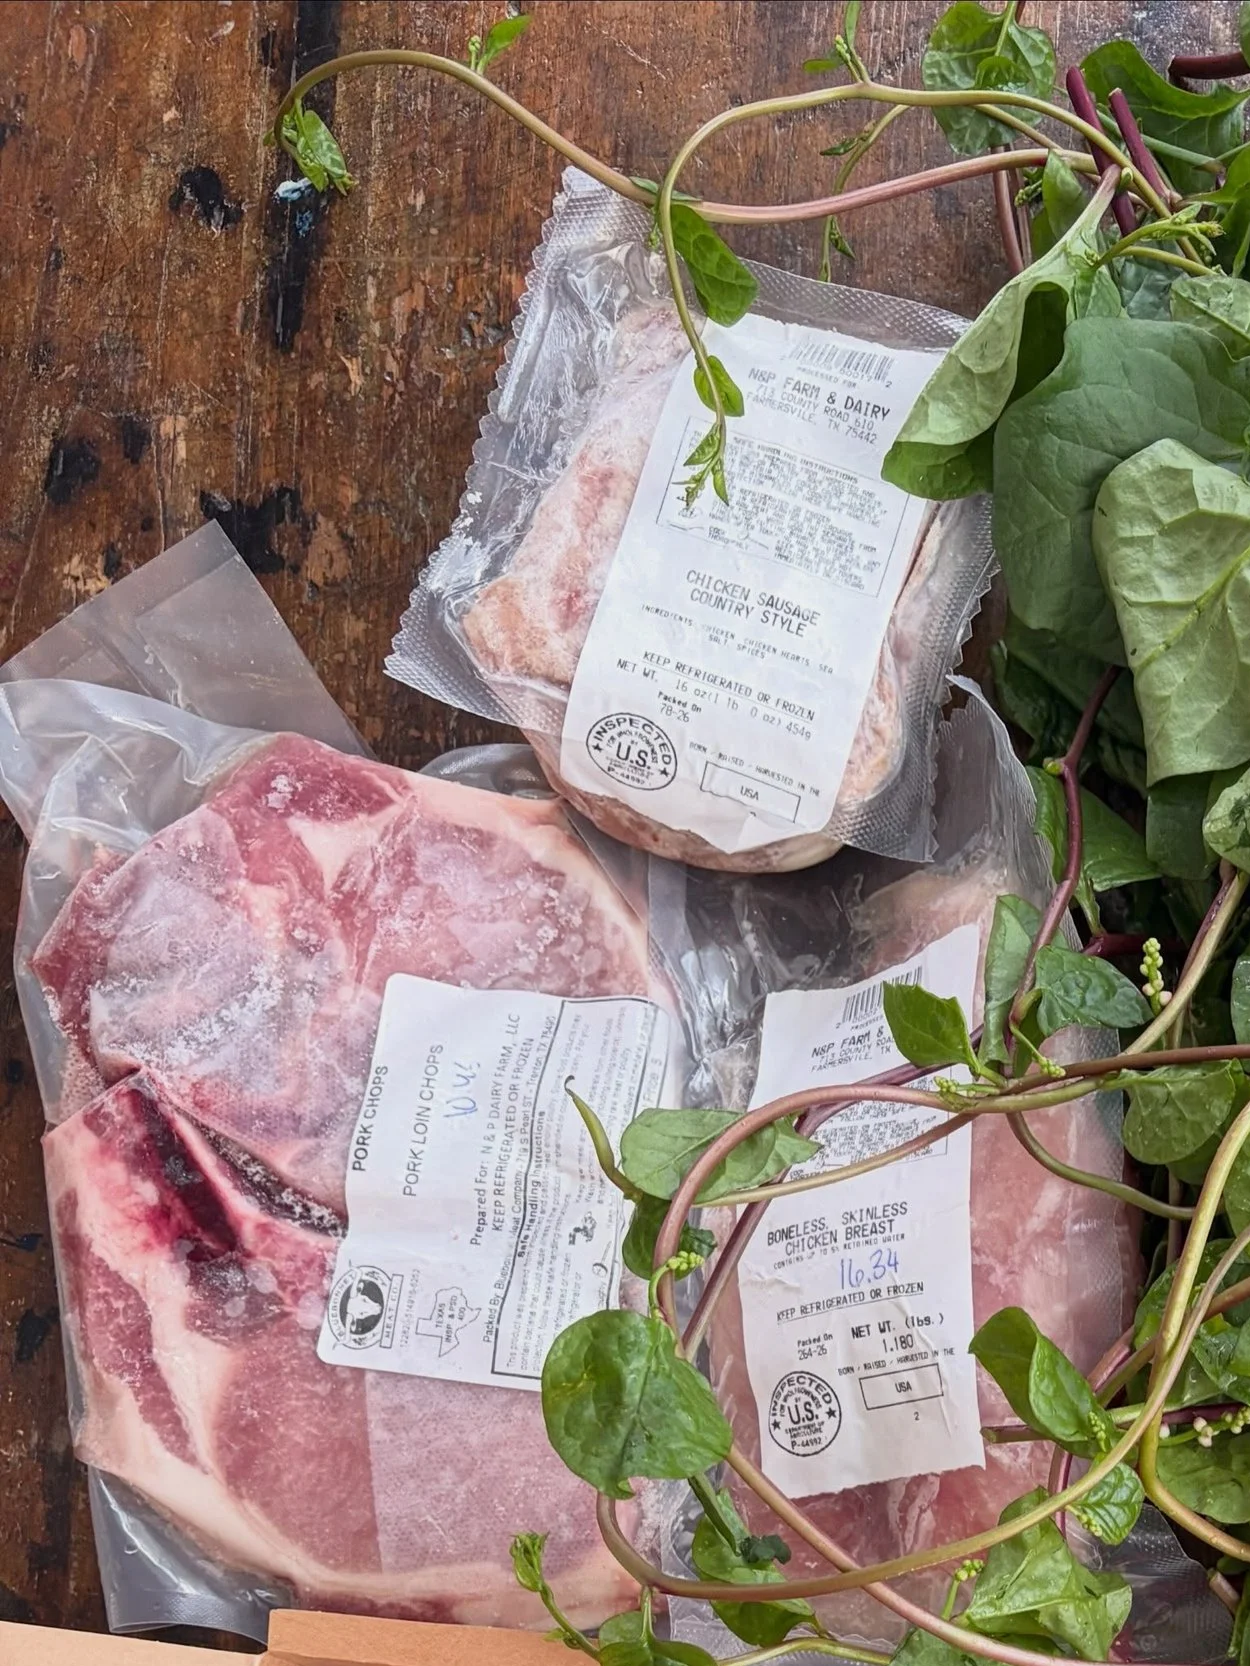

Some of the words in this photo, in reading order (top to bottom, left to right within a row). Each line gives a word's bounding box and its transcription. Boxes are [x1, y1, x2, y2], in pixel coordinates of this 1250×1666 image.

[747, 366, 776, 386] N&P
[783, 377, 821, 400] FARM
[826, 390, 837, 405] &
[843, 395, 890, 422] DAIRY
[779, 391, 819, 412] COUNTY
[822, 405, 850, 423] ROAD
[845, 425, 877, 444] 75442
[685, 568, 750, 603] CHICKEN
[756, 592, 820, 626] SAUSAGE
[689, 587, 753, 620] COUNTRY
[759, 610, 806, 637] STYLE
[616, 658, 636, 674] NET
[674, 679, 688, 693] 16
[725, 698, 739, 712] lb
[642, 650, 670, 669] KEEP
[674, 662, 752, 698] REFRIGERATED
[756, 691, 770, 705] OR
[775, 698, 815, 721] FROZEN
[594, 718, 672, 766] INSPECTED
[614, 741, 654, 769] U.S.
[739, 786, 760, 801] USA
[505, 1012, 520, 1035] LLC
[537, 1040, 547, 1052] TX
[809, 1042, 835, 1058] N&P
[839, 1030, 871, 1048] FARM
[875, 1025, 884, 1038] &
[838, 1041, 872, 1057] COUNTY
[418, 1042, 443, 1101] CHOPS
[493, 1040, 516, 1078] FARM,
[511, 1036, 534, 1080] FROZEN
[487, 1079, 505, 1118] DAIRY
[507, 1082, 521, 1101] OR
[351, 1122, 373, 1172] PORK
[362, 1063, 388, 1120] CHOPS
[411, 1104, 431, 1144] LOIN
[486, 1121, 497, 1129] P
[519, 1108, 531, 1134] Pearl
[480, 1141, 493, 1154] N
[482, 1131, 495, 1142] &
[493, 1103, 518, 1196] REFRIGERATED
[529, 1109, 546, 1177] Instructions
[402, 1147, 423, 1198] PORK
[473, 1159, 490, 1184] For:
[510, 1169, 527, 1214] Company
[524, 1179, 542, 1232] Handling
[468, 1186, 487, 1246] Prepared
[490, 1198, 506, 1232] KEEP
[840, 1201, 909, 1225] SKINLESS
[517, 1233, 530, 1258] Safe
[783, 1229, 838, 1256] CHICKEN
[843, 1218, 897, 1241] BREAST
[842, 1238, 878, 1250] RETAINED
[881, 1233, 905, 1244] WATER
[835, 1245, 902, 1290] 16.34
[489, 1292, 501, 1305] By
[776, 1307, 796, 1321] KEEP
[799, 1291, 865, 1315] REFRIGERATED
[869, 1287, 882, 1299] OR
[886, 1281, 924, 1296] FROZEN
[383, 1307, 394, 1338] MEAT
[435, 1302, 445, 1329] TEXAS
[482, 1307, 497, 1342] Packed
[851, 1324, 871, 1339] NET
[878, 1320, 895, 1333] WT.
[444, 1323, 452, 1343] INSP
[796, 1335, 821, 1347] Packed
[882, 1333, 914, 1353] 1.180
[797, 1344, 827, 1360] 264-26
[837, 1365, 854, 1375] BORN
[863, 1359, 886, 1371] RAISED
[896, 1352, 928, 1363] HARVESTED
[943, 1347, 954, 1356] THE
[769, 1373, 833, 1416] INSPECTED
[895, 1380, 912, 1392] USA
[787, 1400, 819, 1424] U.S.
[913, 1410, 920, 1422] 2
